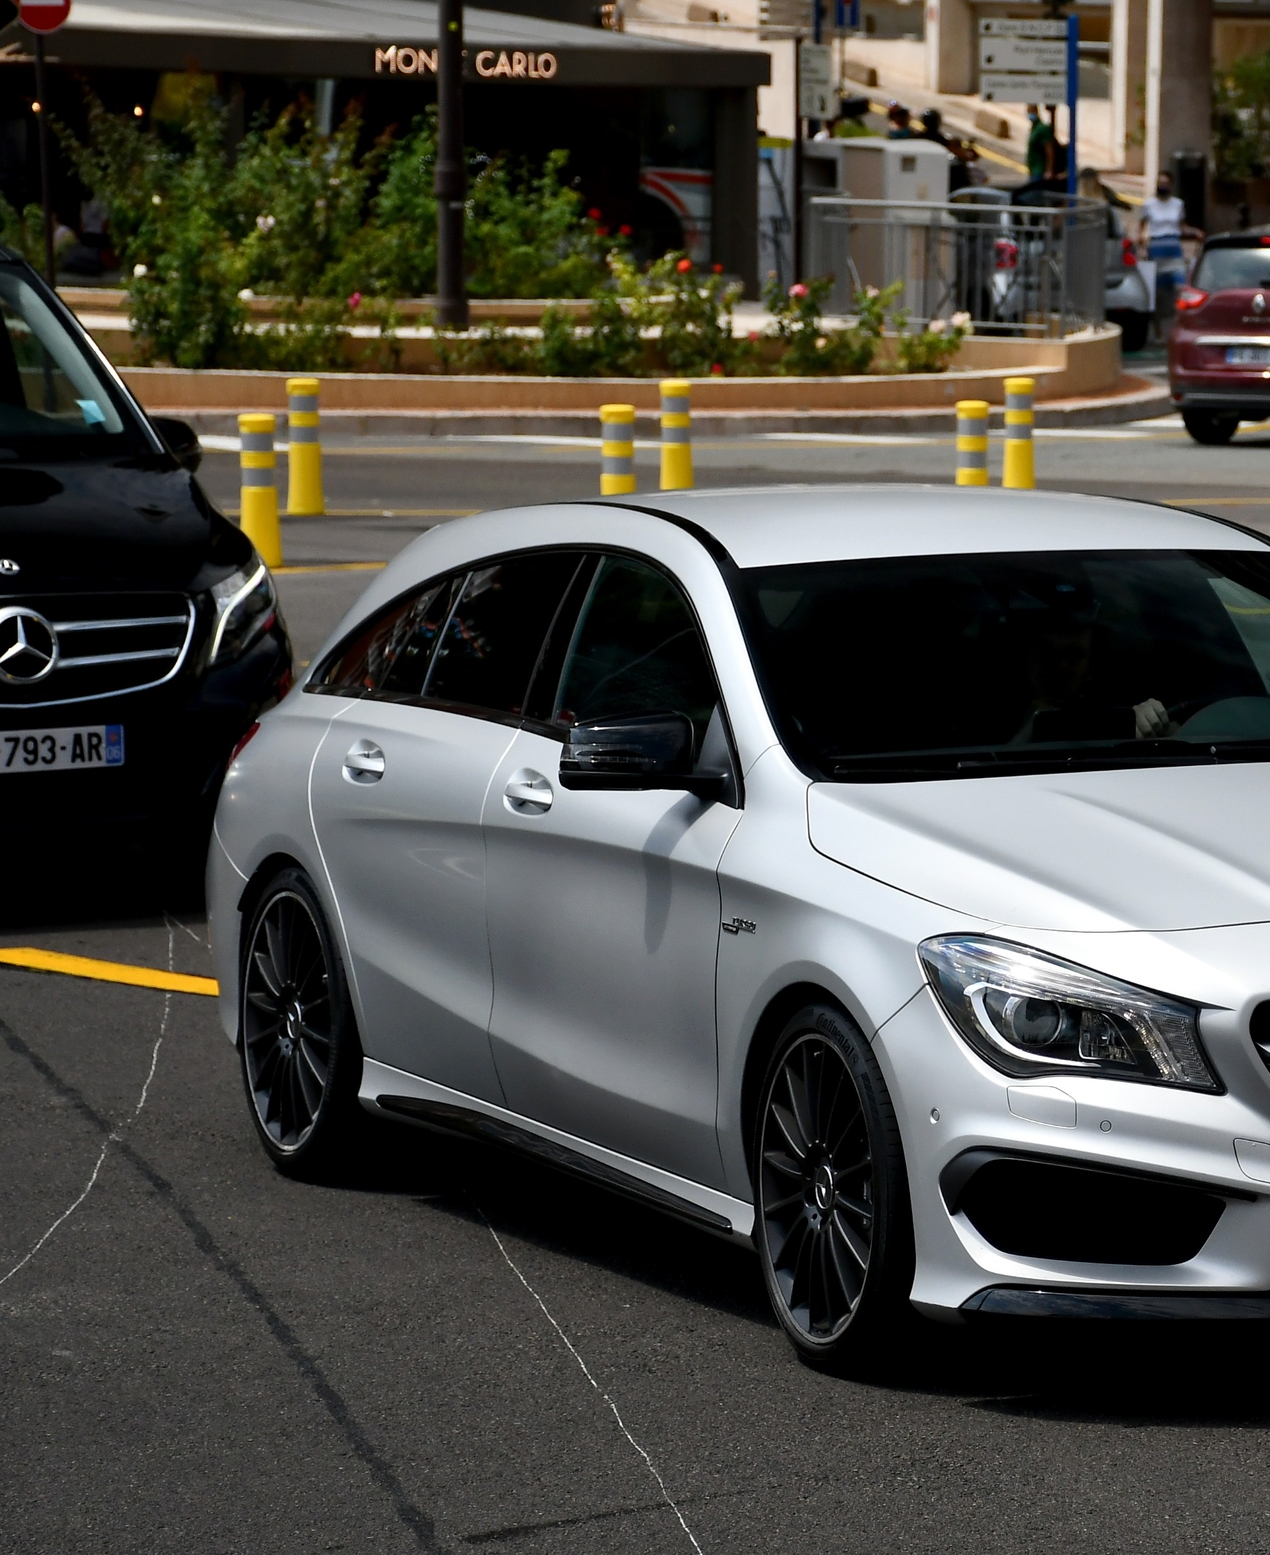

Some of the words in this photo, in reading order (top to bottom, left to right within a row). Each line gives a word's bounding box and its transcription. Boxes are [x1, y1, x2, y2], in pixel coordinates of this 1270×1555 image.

[375, 45, 467, 76] MON
[475, 50, 557, 79] CARLO
[816, 1012, 855, 1058] Continental
